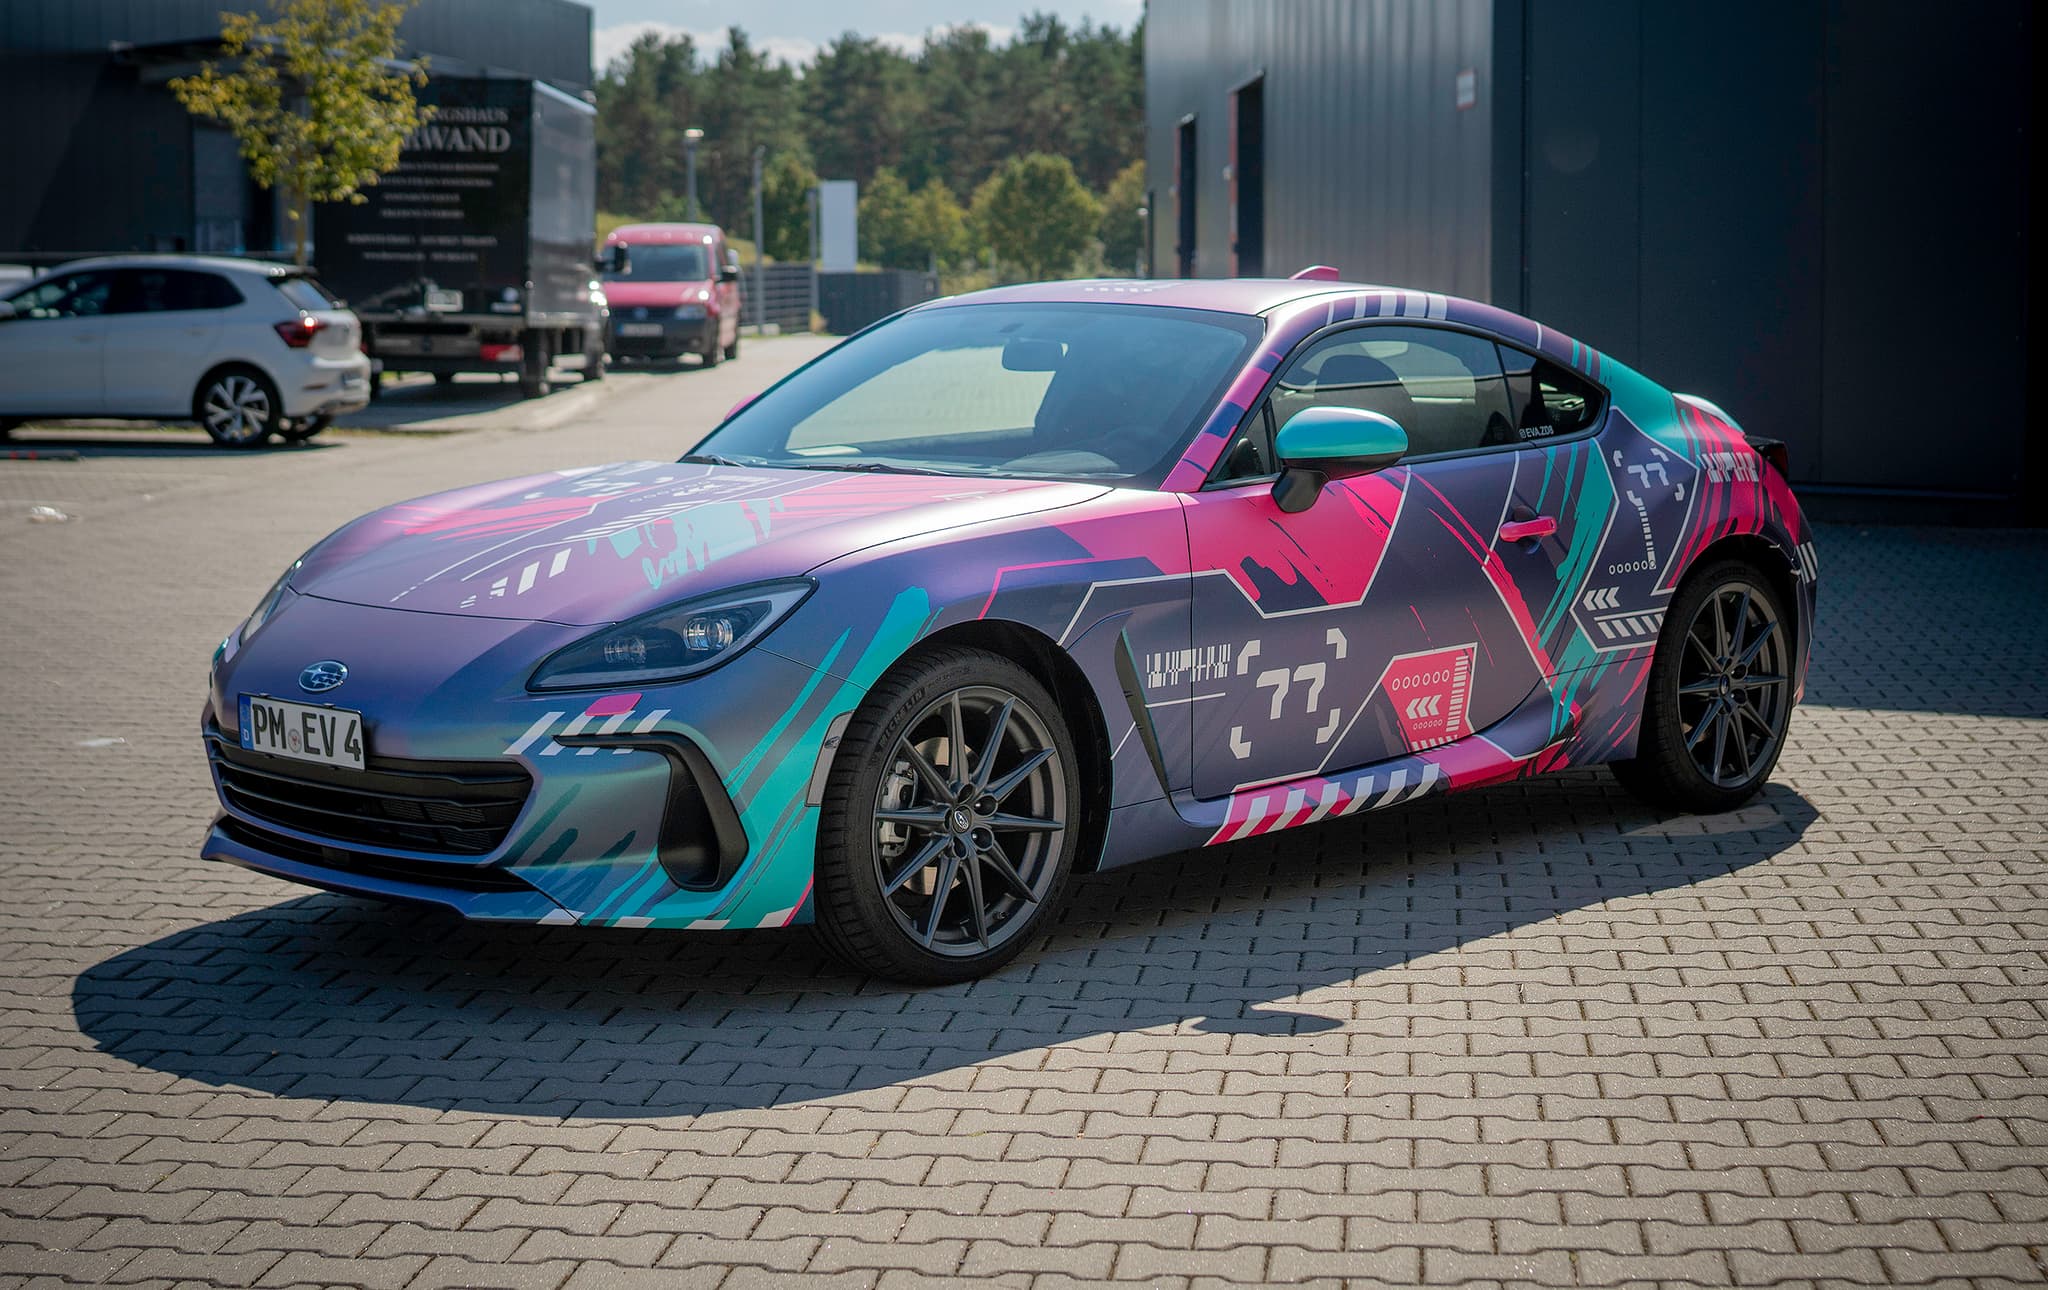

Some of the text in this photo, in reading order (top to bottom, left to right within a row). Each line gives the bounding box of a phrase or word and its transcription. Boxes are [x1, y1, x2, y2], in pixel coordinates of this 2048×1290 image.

[252, 703, 362, 762] PM EV 4
